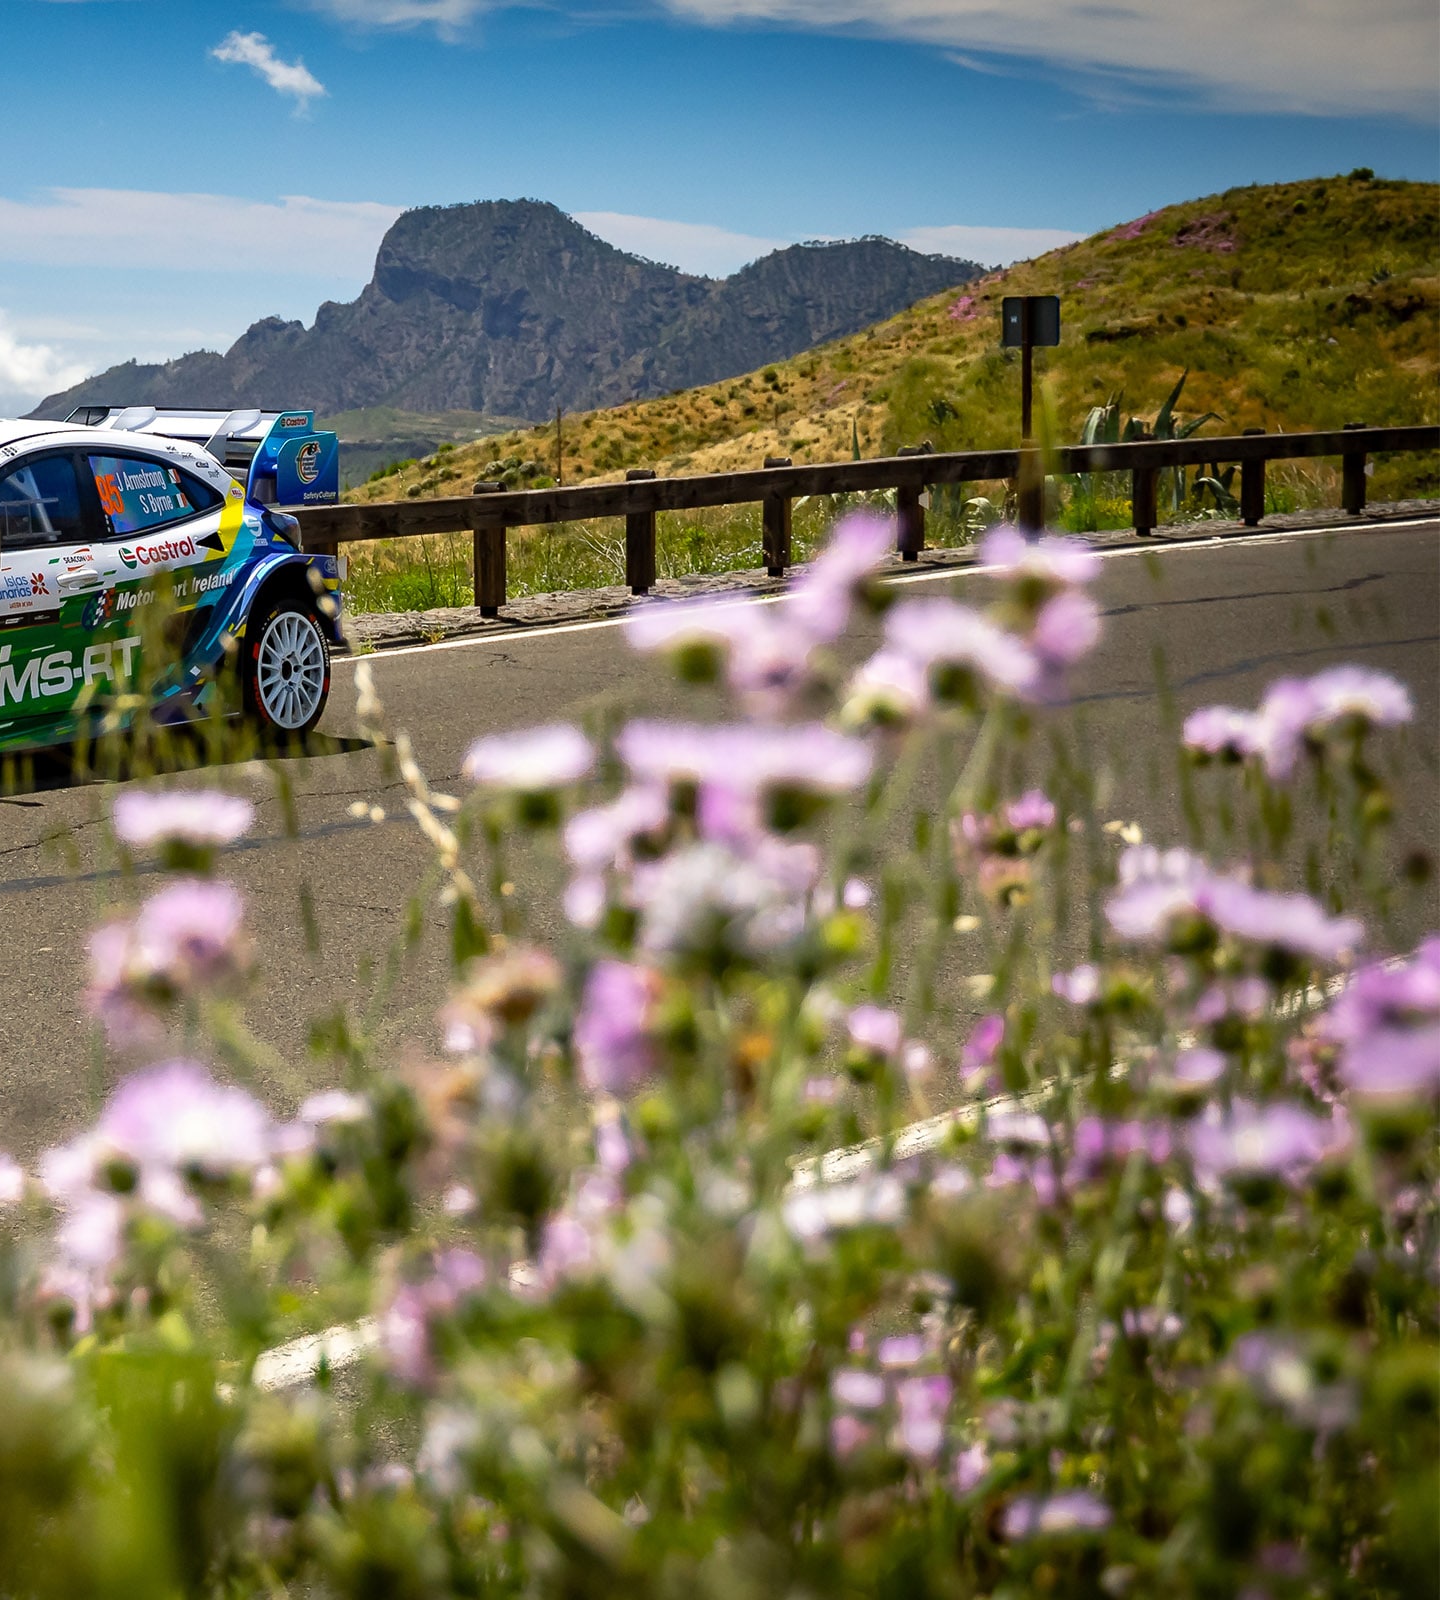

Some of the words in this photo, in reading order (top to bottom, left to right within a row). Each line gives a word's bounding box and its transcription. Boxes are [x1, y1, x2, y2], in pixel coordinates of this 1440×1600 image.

[94, 474, 125, 516] 95
[117, 472, 124, 492] J
[125, 469, 167, 492] Armstrong
[139, 495, 149, 514] S
[150, 493, 174, 516] Byrne
[135, 535, 196, 565] Castrol
[4, 575, 29, 588] Islas
[116, 583, 187, 611] Motorort
[192, 569, 238, 594] Ireland
